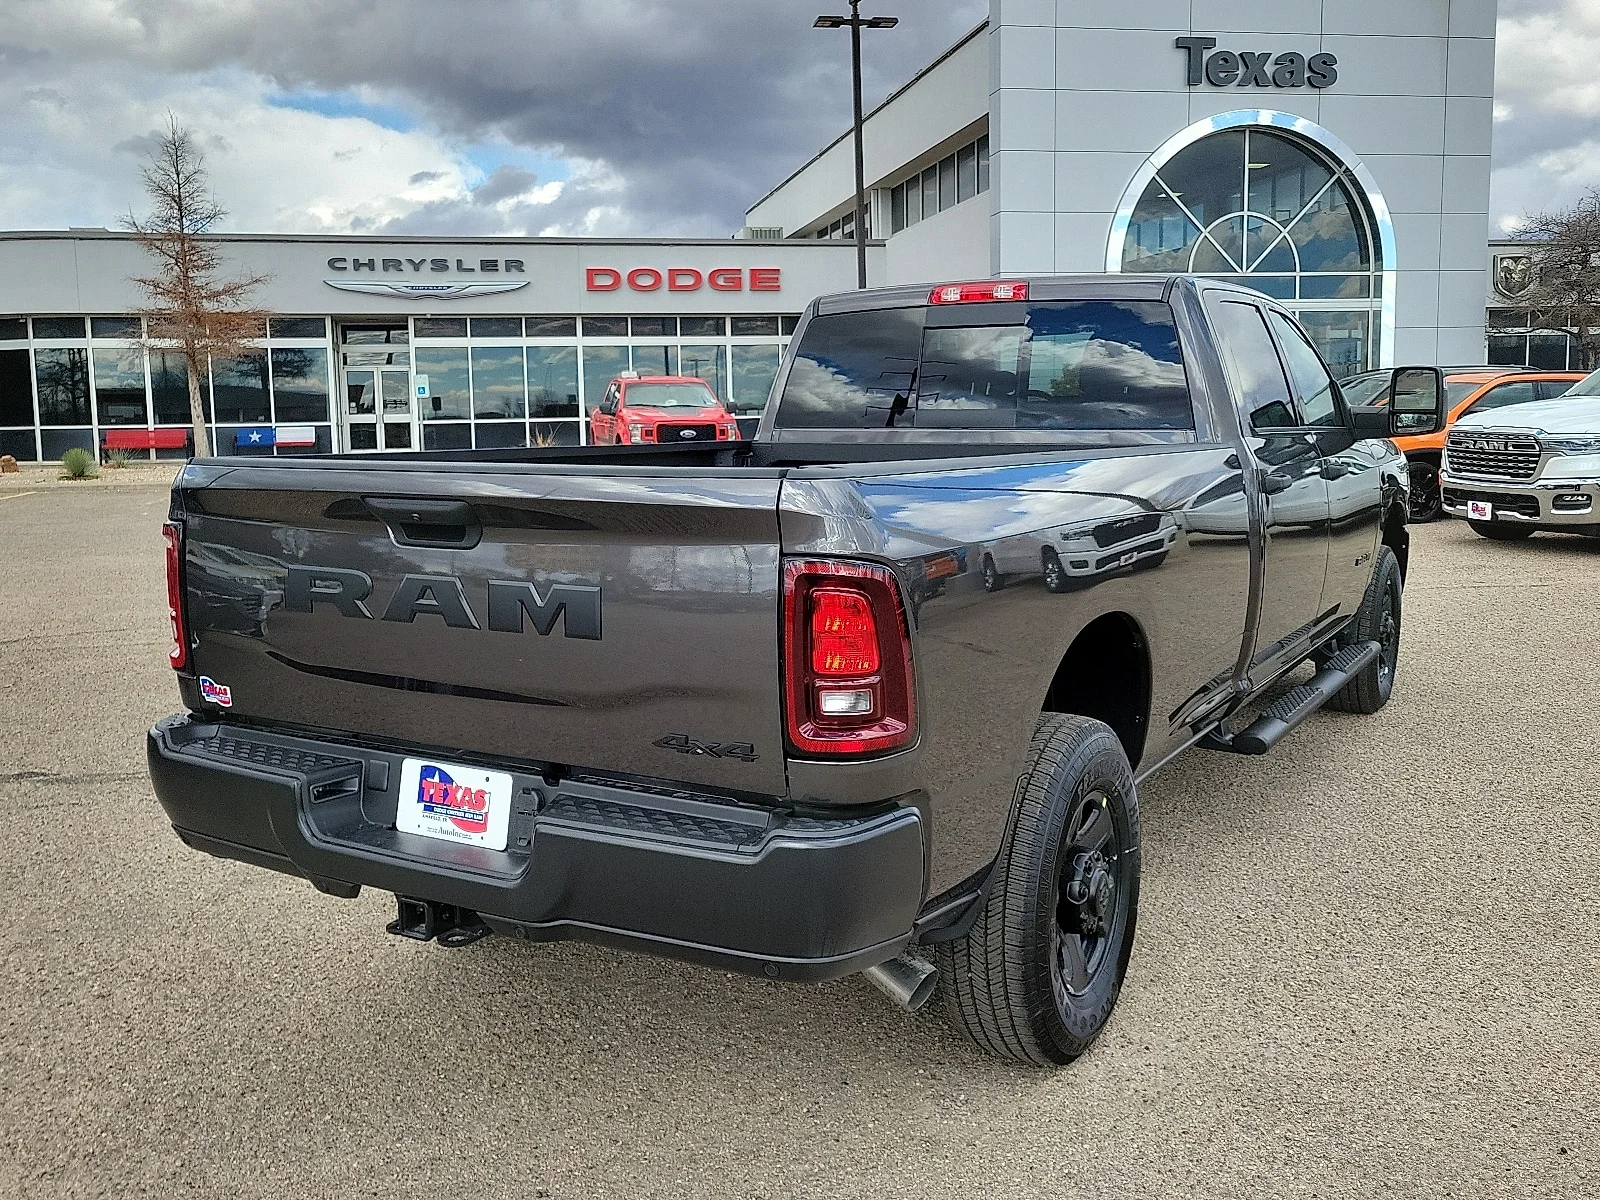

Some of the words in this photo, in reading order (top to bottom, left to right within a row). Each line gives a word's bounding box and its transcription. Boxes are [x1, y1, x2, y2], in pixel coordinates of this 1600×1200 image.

[1175, 36, 1338, 88] Texas
[327, 257, 525, 273] CHRYSLER
[585, 267, 781, 292] DODGE
[1461, 439, 1507, 451] RAM
[283, 563, 603, 641] RAM
[422, 779, 487, 811] TEXAS
